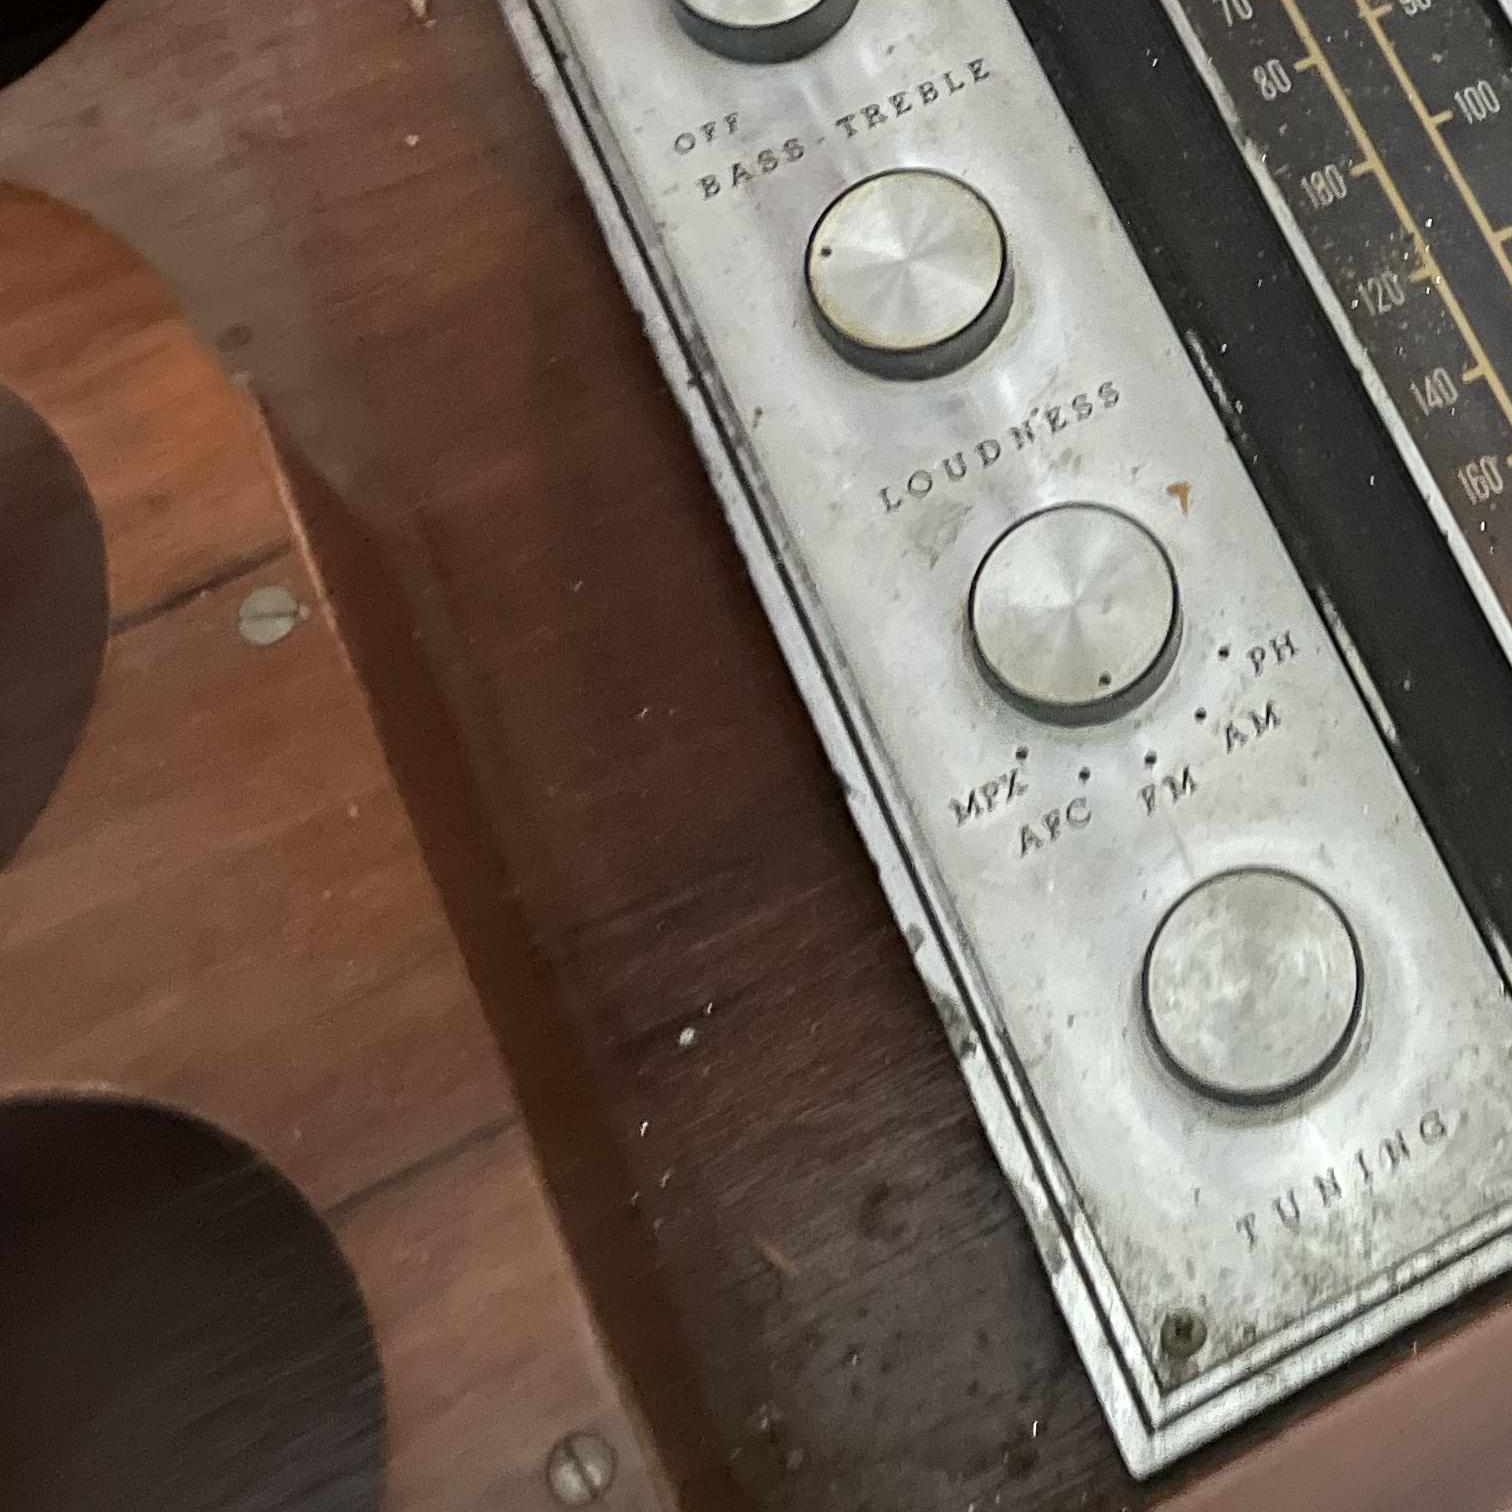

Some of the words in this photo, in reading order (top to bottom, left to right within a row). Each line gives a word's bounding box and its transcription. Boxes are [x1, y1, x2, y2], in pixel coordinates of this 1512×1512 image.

[1252, 58, 1293, 102] 80
[1453, 78, 1502, 125] 100
[672, 111, 741, 157] OFF
[1354, 270, 1407, 319] 120
[1409, 366, 1460, 418] 140
[877, 380, 1122, 516] LOUDNESS
[1456, 454, 1506, 506] 160
[1245, 630, 1300, 677] PH
[1224, 701, 1283, 755] AM
[947, 767, 1030, 828] MPX
[1017, 796, 1093, 859] AFC
[1137, 764, 1200, 818] FM
[1235, 1109, 1448, 1254] TUNING
